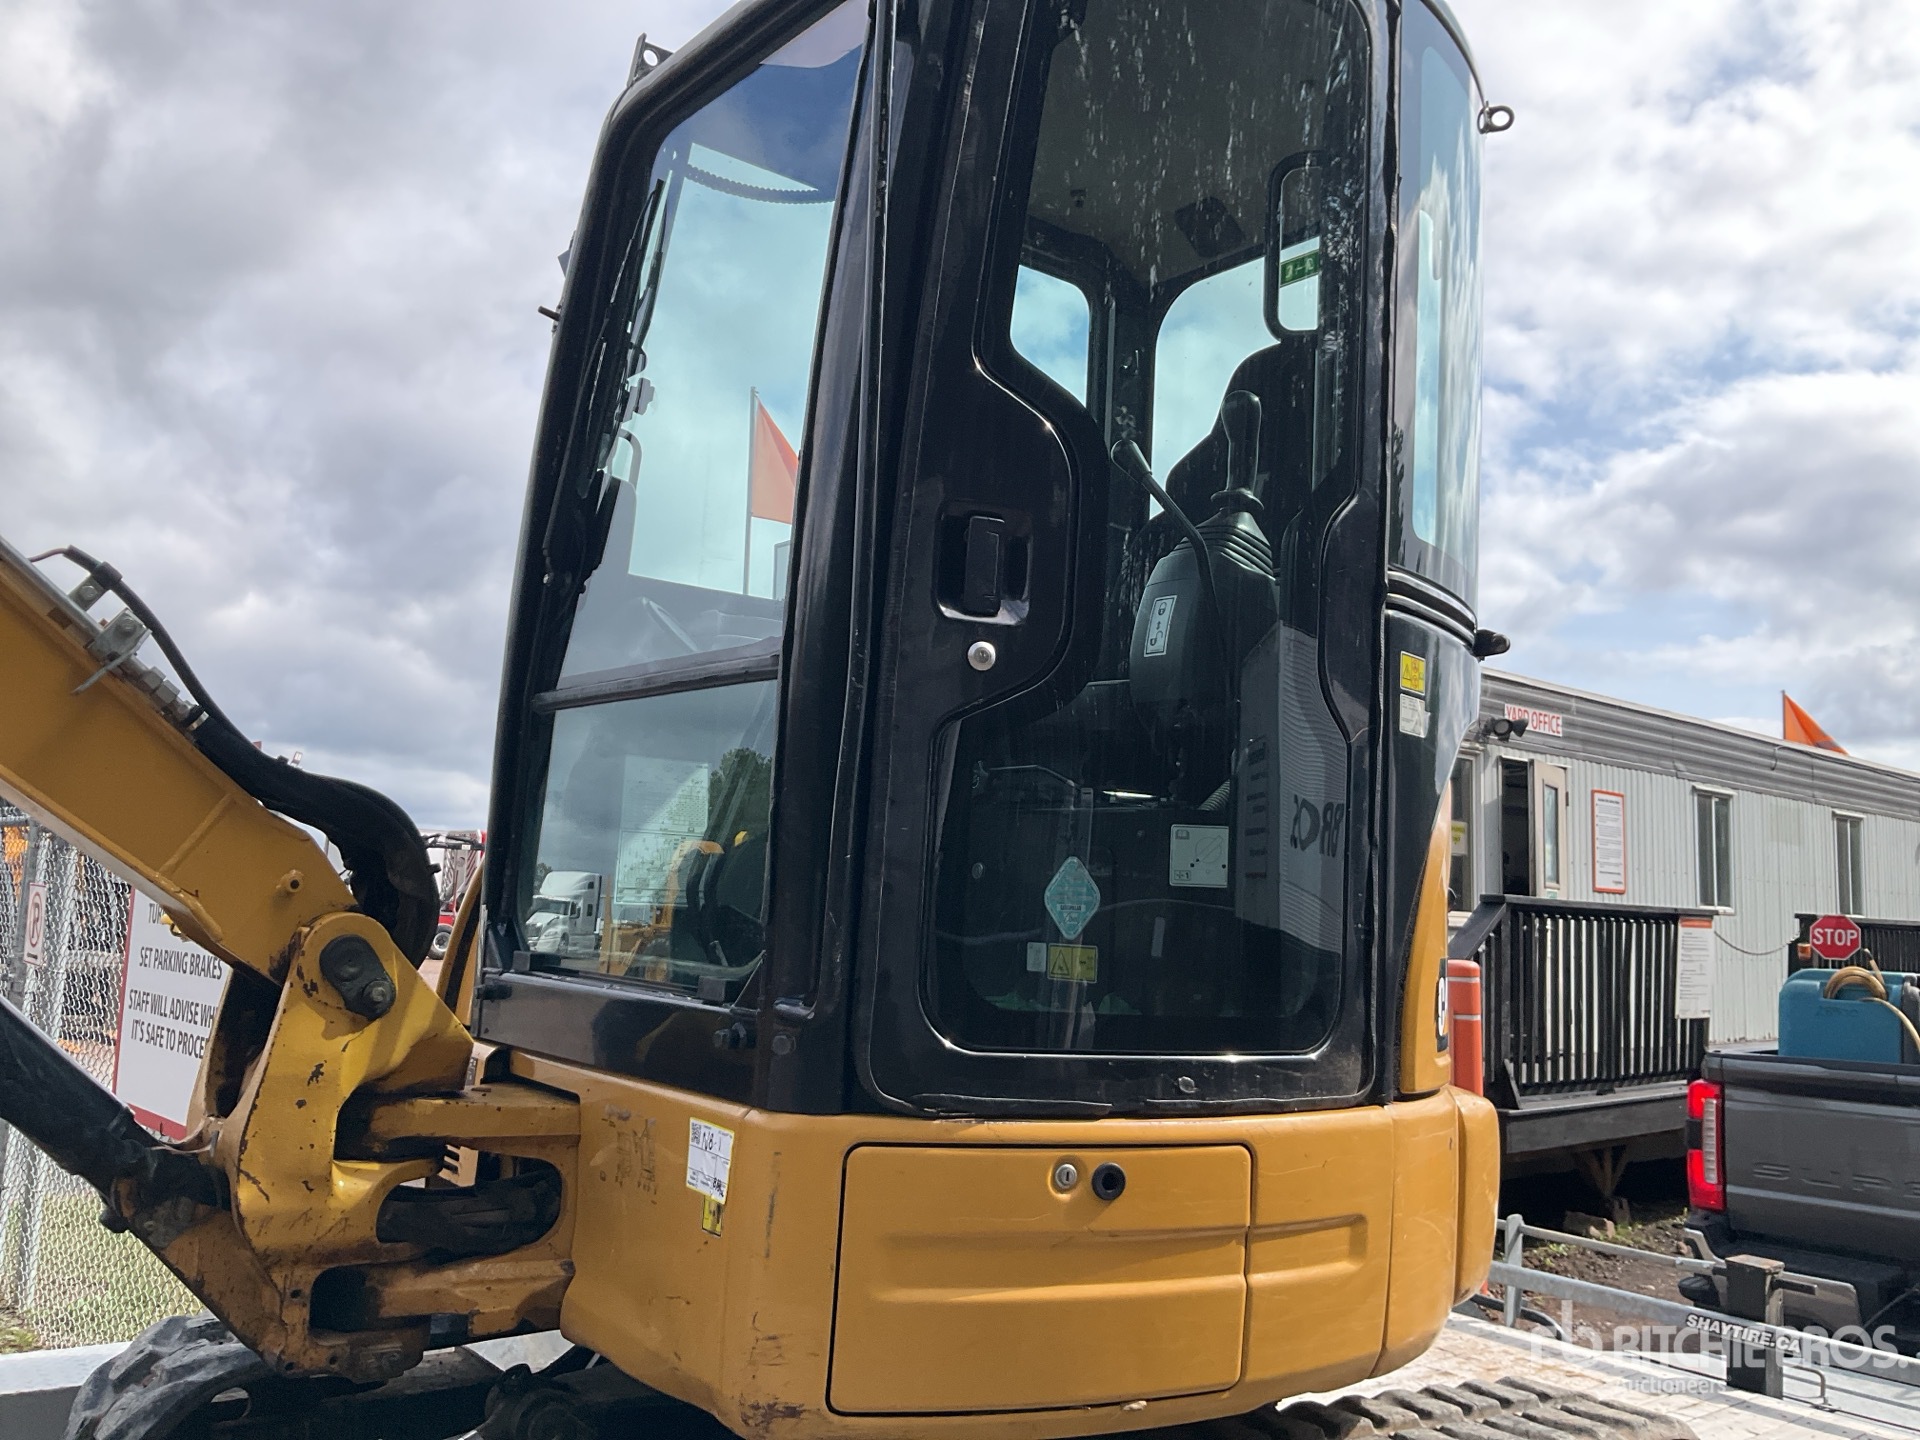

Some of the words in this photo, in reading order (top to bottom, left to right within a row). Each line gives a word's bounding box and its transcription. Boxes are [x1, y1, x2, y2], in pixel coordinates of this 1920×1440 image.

[1531, 711, 1561, 734] OFFICE
[1812, 928, 1858, 946] STOP
[139, 946, 153, 968] SET
[153, 949, 188, 974] PARKING
[189, 953, 222, 980] BRAKES
[128, 989, 150, 1013] STAFF
[150, 993, 167, 1018] WILL
[169, 998, 198, 1025] ADVISE
[200, 1004, 218, 1028] WH
[131, 1019, 144, 1042] IT'S
[145, 1023, 164, 1048] SAFE
[165, 1028, 176, 1051] TO
[1686, 1313, 1801, 1354] SHAYTIRE.CA
